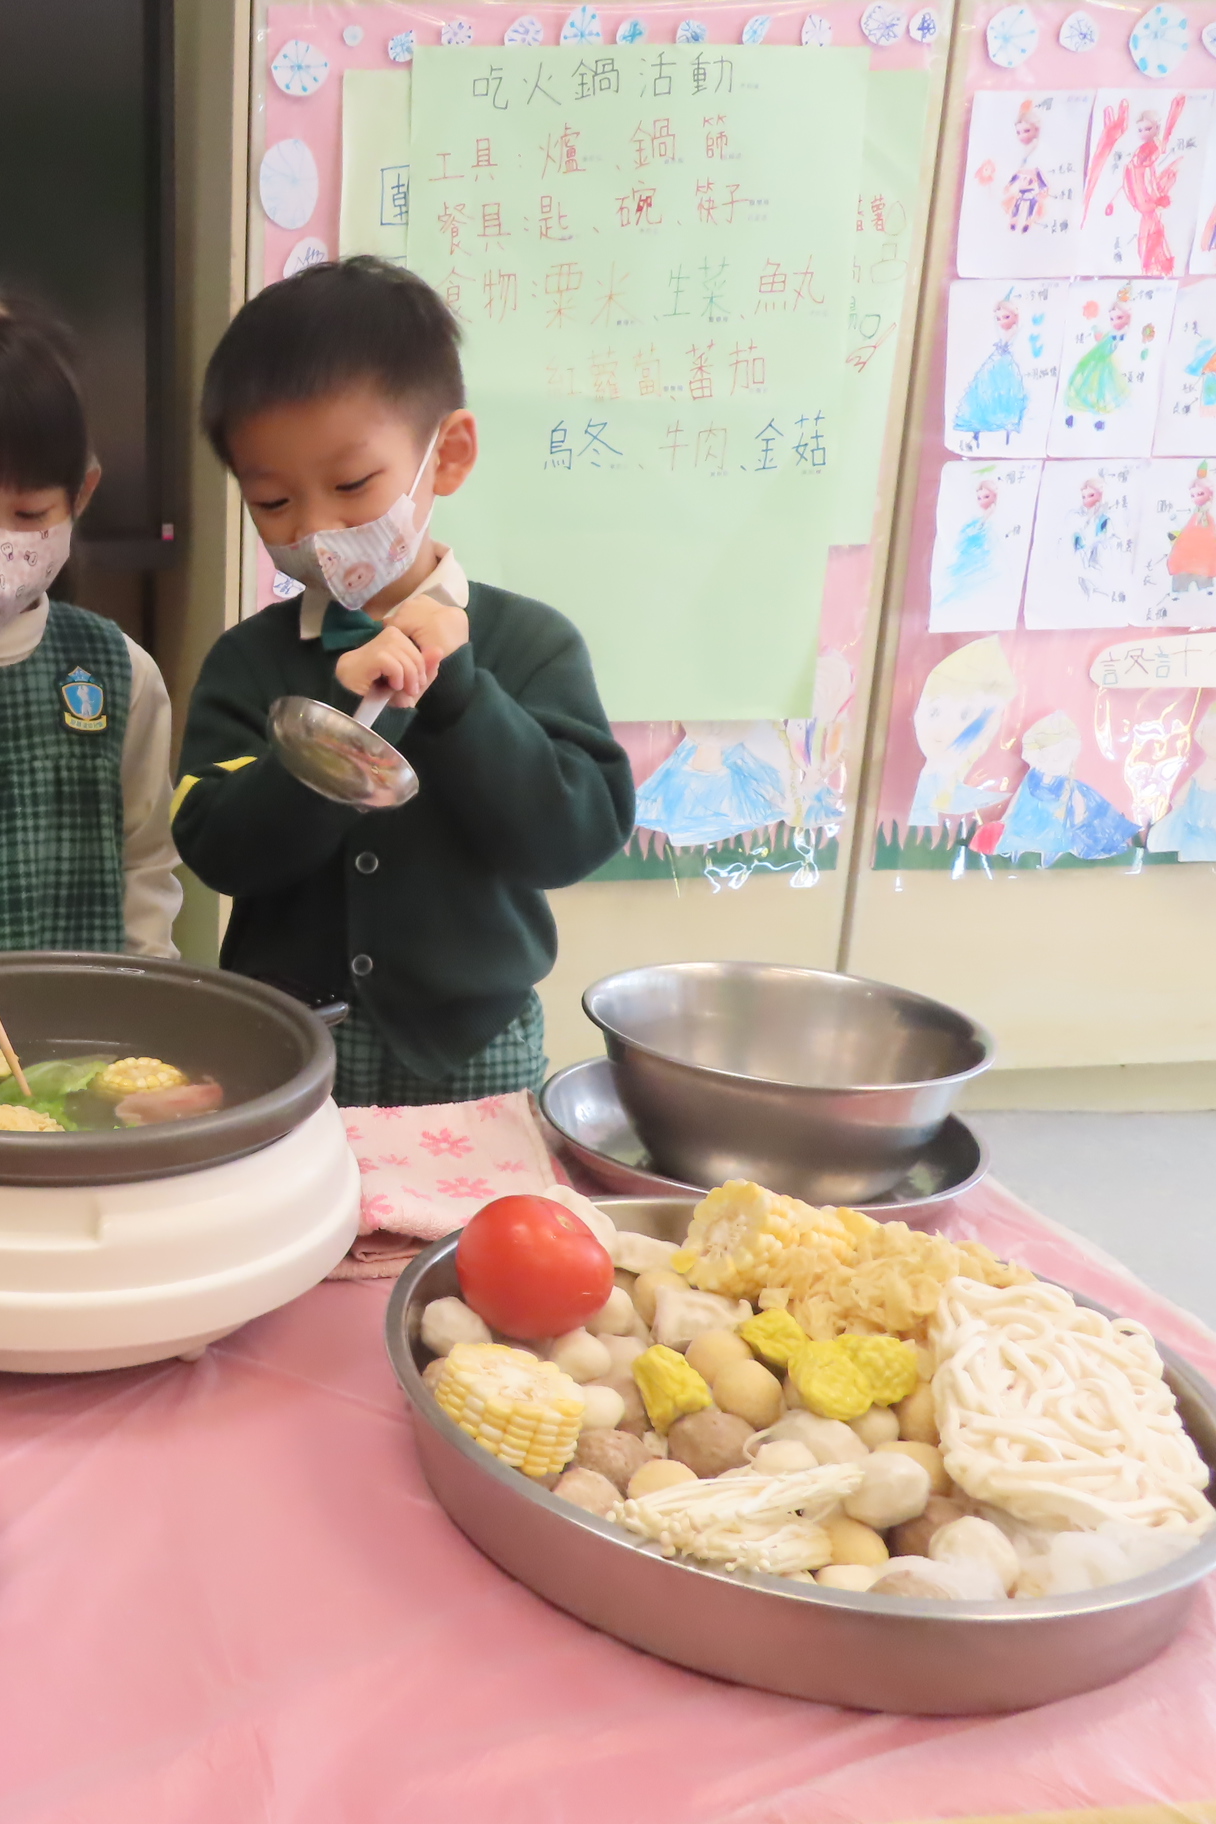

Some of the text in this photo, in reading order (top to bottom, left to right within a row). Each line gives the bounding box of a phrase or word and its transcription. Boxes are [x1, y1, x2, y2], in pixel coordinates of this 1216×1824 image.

[472, 51, 733, 110] 吃火鍋活動
[1100, 637, 1216, 685] 設計
